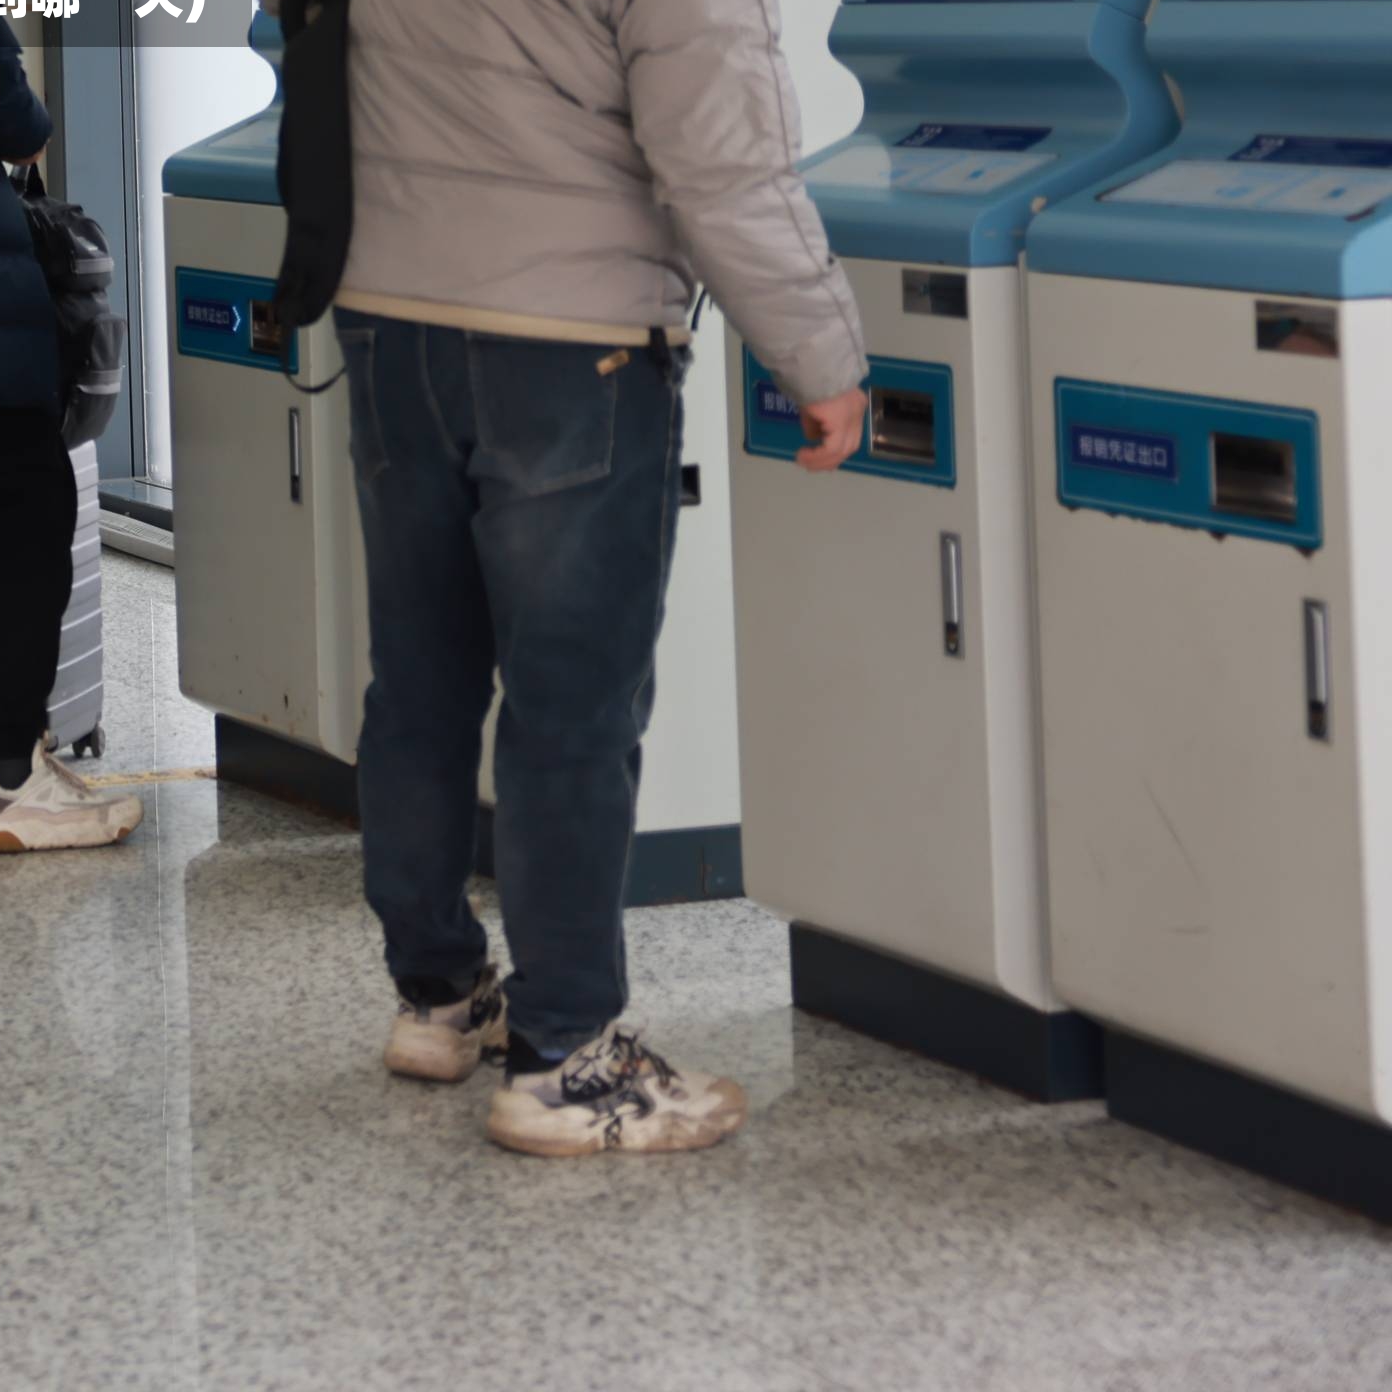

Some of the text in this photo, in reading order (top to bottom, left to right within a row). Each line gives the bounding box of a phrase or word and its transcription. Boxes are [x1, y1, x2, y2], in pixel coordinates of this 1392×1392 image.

[1079, 434, 1167, 468] 报销凭证出口
